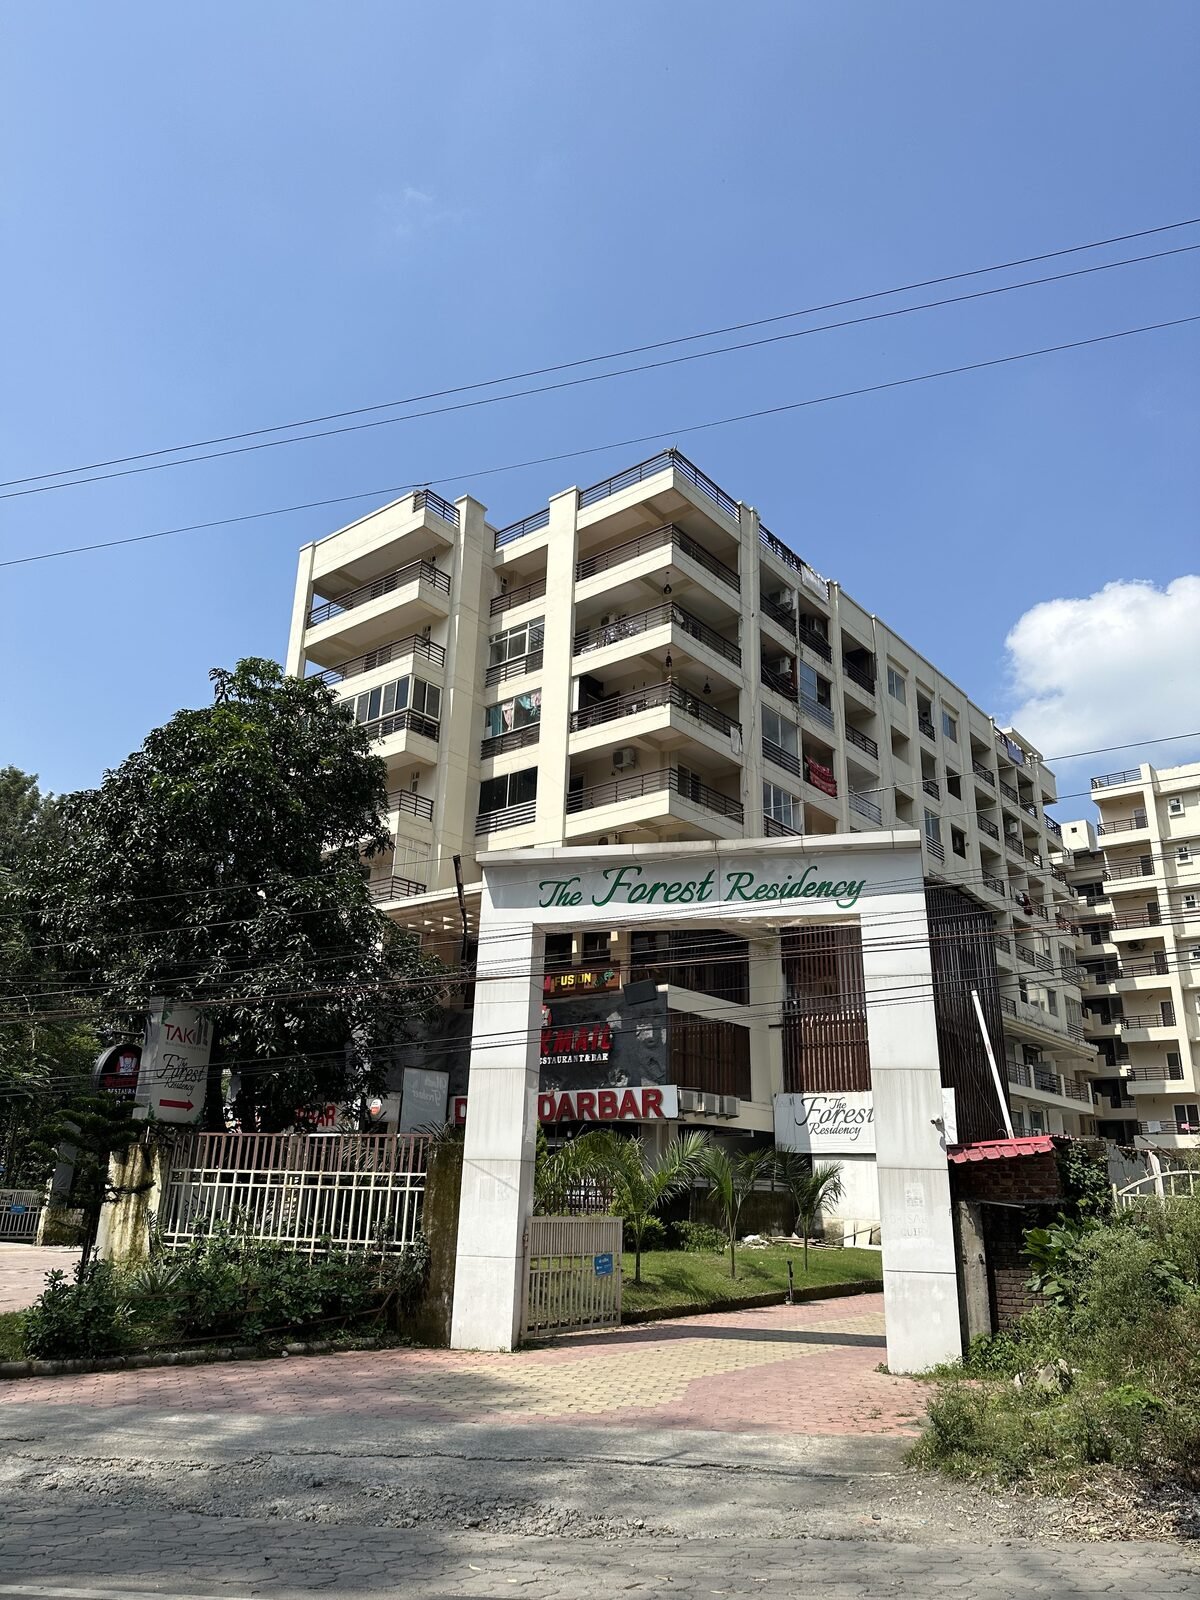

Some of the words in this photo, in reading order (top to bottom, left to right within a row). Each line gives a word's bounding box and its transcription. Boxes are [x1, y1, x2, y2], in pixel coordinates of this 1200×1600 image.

[538, 877, 583, 908] The
[592, 866, 716, 907] Forest
[724, 865, 867, 909] Residency
[157, 1053, 205, 1083] Forest
[538, 1088, 665, 1121] DARBAR
[828, 1096, 847, 1110] The
[808, 1120, 862, 1142] Residency
